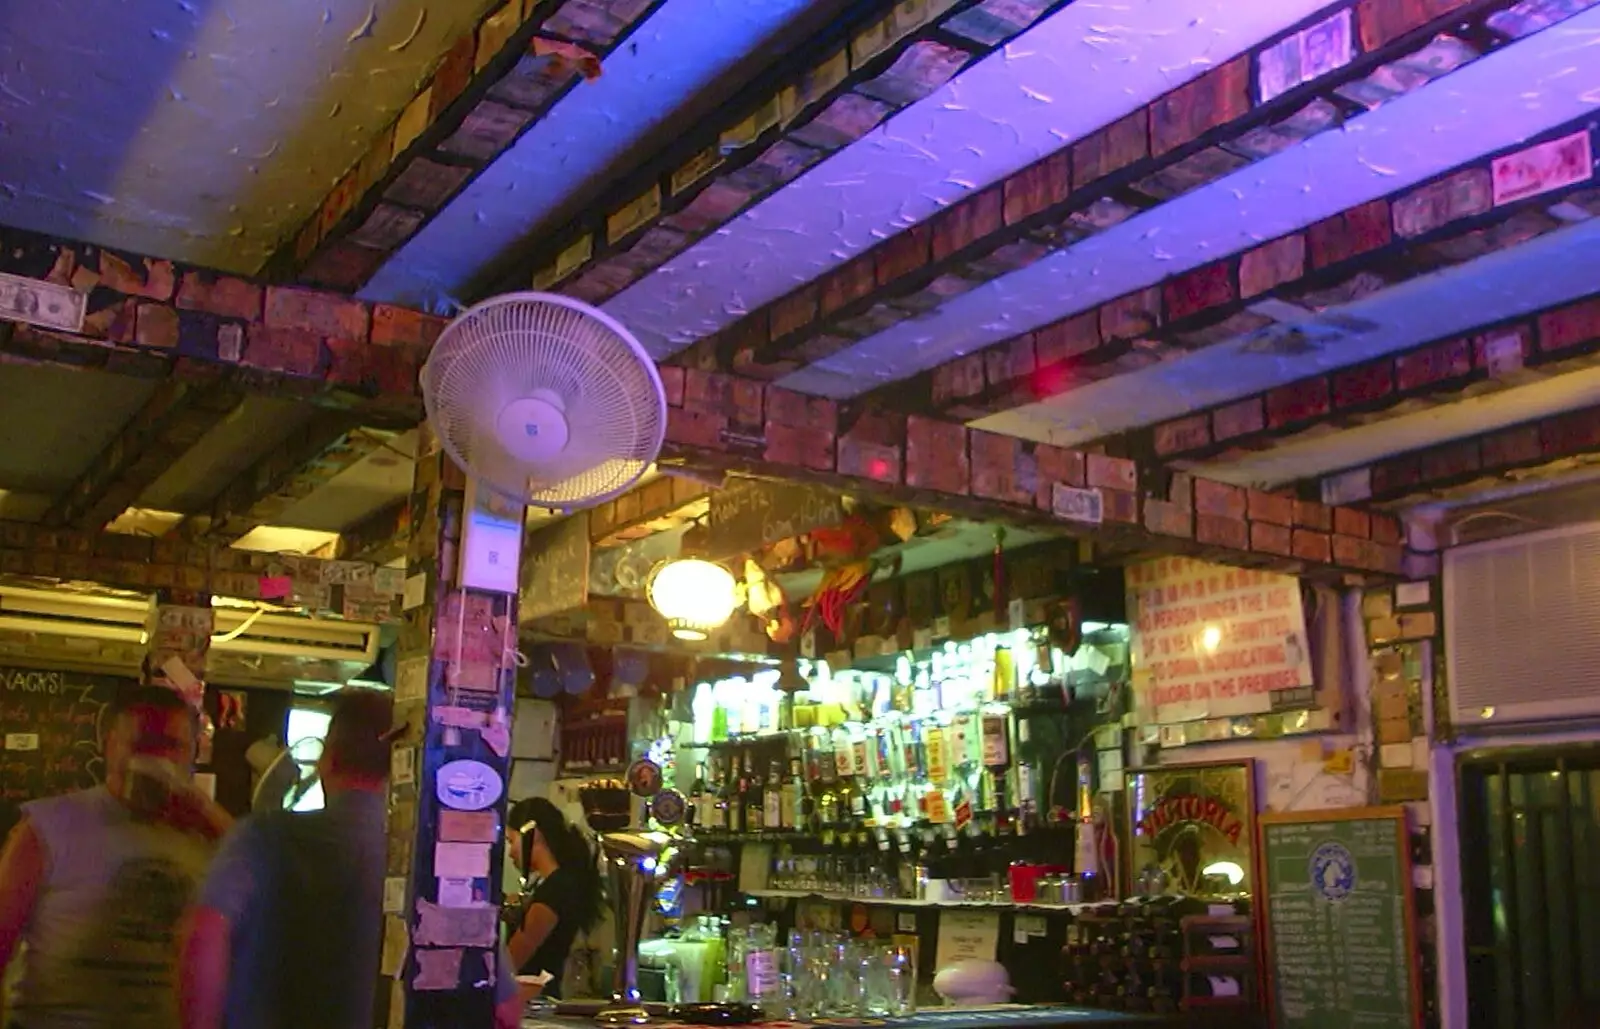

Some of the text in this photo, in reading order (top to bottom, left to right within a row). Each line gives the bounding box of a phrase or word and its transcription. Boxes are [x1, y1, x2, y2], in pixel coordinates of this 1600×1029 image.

[1153, 606, 1197, 630] PERSON
[1199, 597, 1239, 621] UNDER
[1240, 592, 1263, 613] THE
[1222, 614, 1290, 645] ERMITTED
[1193, 680, 1211, 700] ON
[1212, 677, 1237, 699] THE
[1238, 669, 1301, 695] PREMISES
